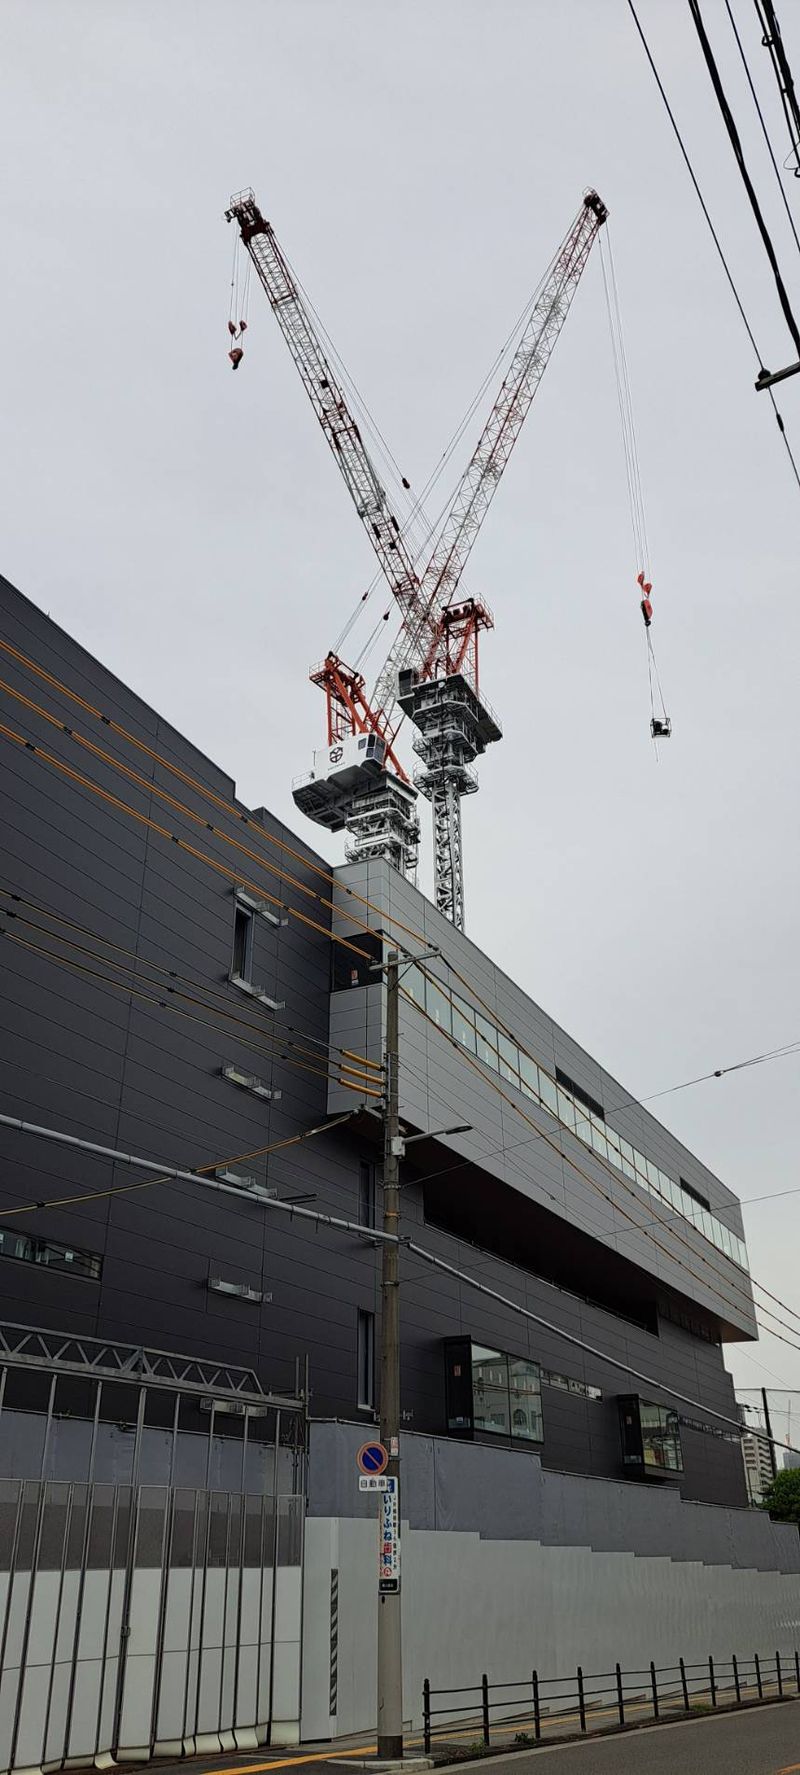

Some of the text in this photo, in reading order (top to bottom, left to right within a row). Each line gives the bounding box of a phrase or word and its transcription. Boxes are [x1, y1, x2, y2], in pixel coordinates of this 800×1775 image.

[360, 1479, 386, 1488] 自動車
[383, 1495, 392, 1566] いりふね歯科
